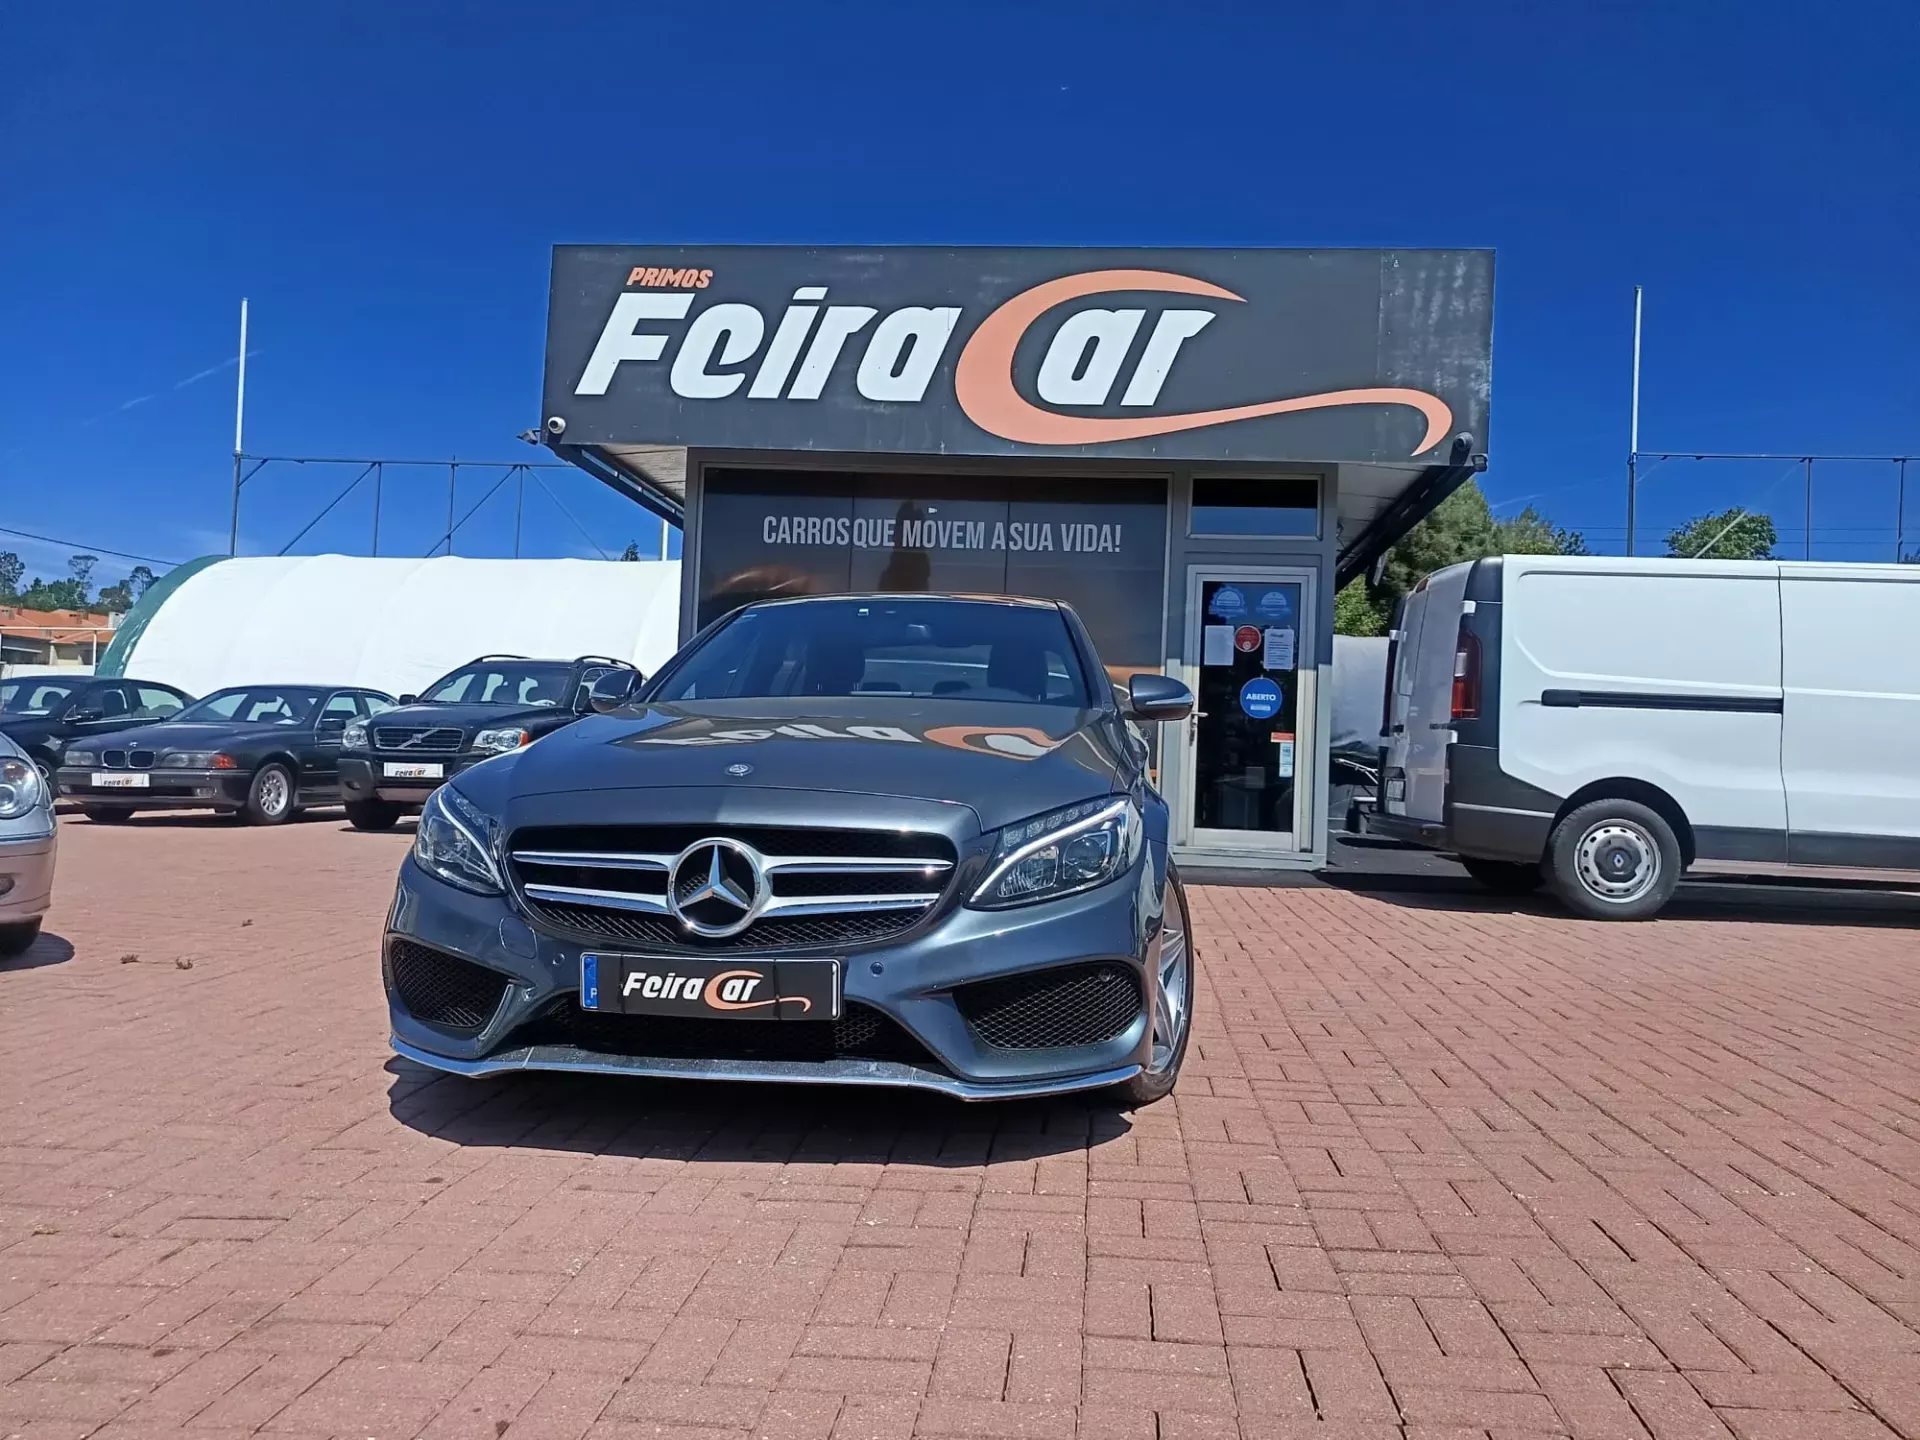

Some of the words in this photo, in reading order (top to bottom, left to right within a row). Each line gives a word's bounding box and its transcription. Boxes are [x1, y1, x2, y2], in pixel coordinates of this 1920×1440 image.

[626, 267, 713, 288] PRIMOS
[763, 516, 850, 546] CARROS
[853, 518, 896, 548] QUE
[902, 519, 985, 549] MOVEM
[991, 521, 1007, 550] A
[1009, 522, 1054, 551] SUA
[1061, 523, 1121, 553] VIDA!
[1245, 692, 1276, 702] ABERTO
[622, 970, 811, 1012] FeiraCar
